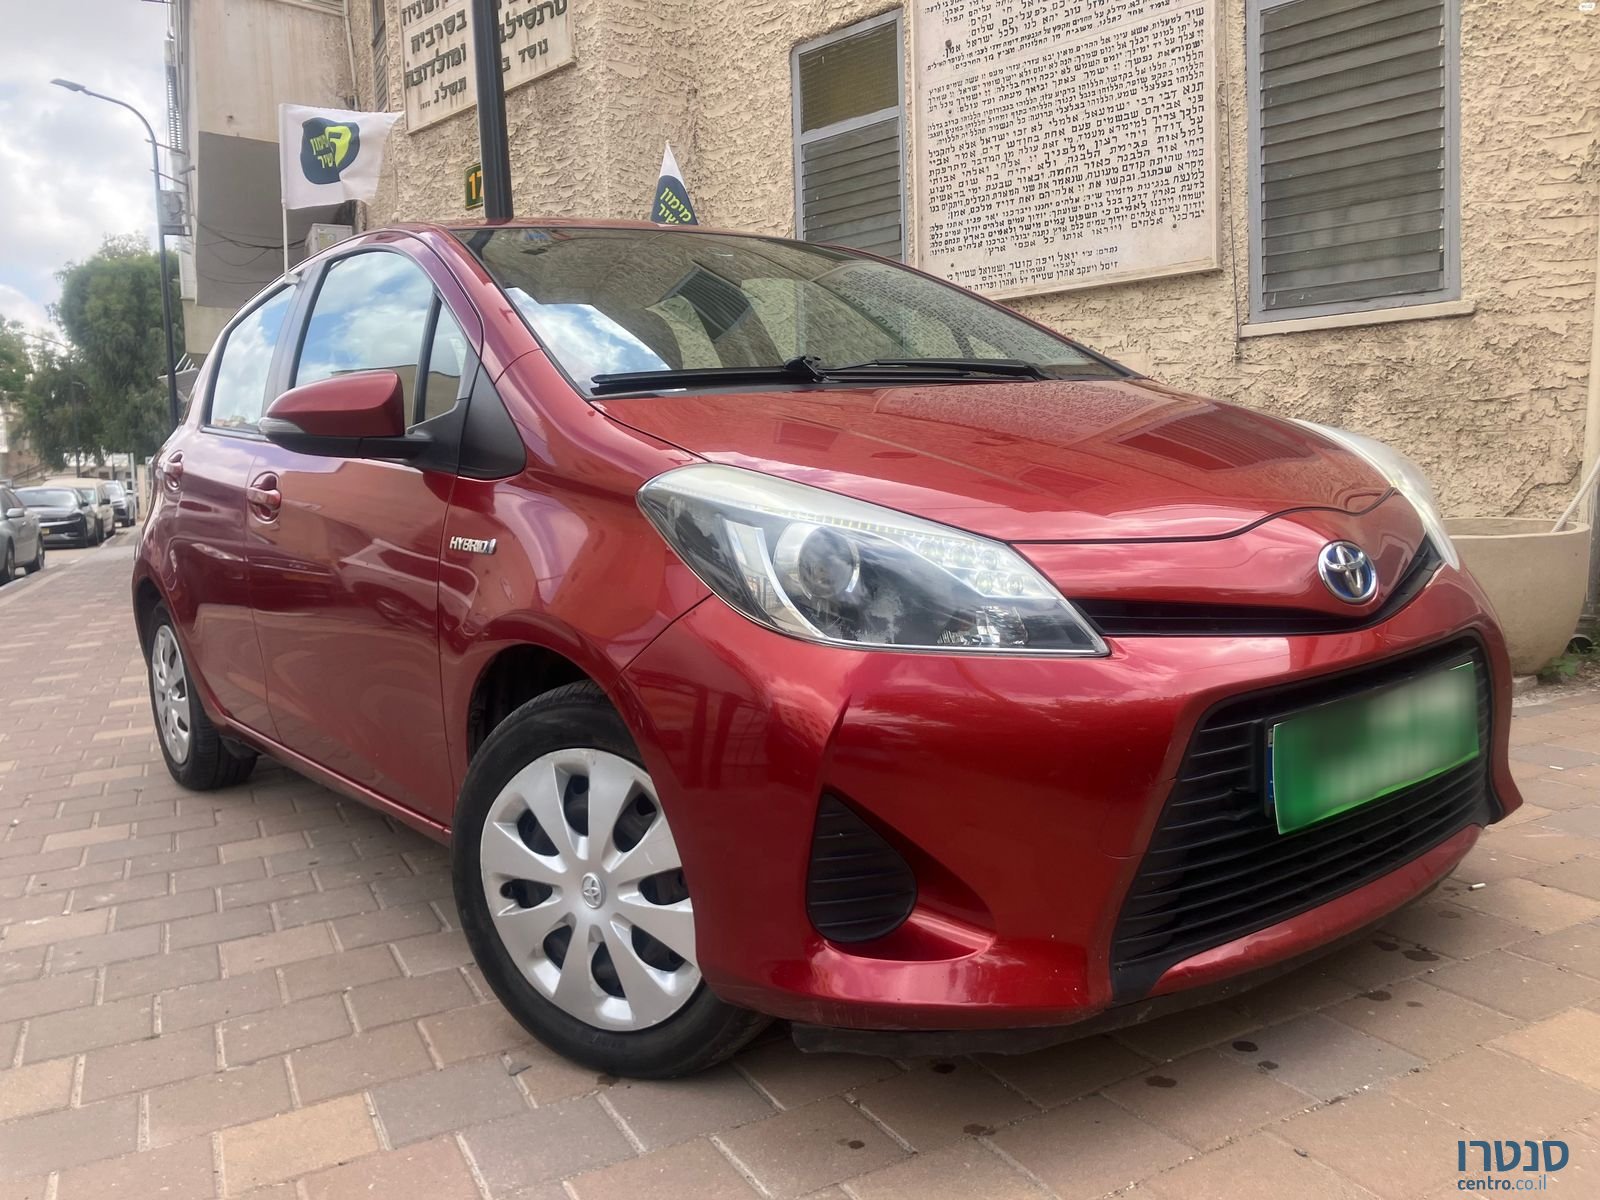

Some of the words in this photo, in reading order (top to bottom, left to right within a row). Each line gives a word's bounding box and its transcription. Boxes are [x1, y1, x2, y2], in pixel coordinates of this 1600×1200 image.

[411, 8, 467, 54] בסרביה
[518, 38, 548, 63] נוסד
[1003, 150, 1015, 161] מן
[660, 187, 692, 222] מימון
[449, 536, 488, 553] HYBRID
